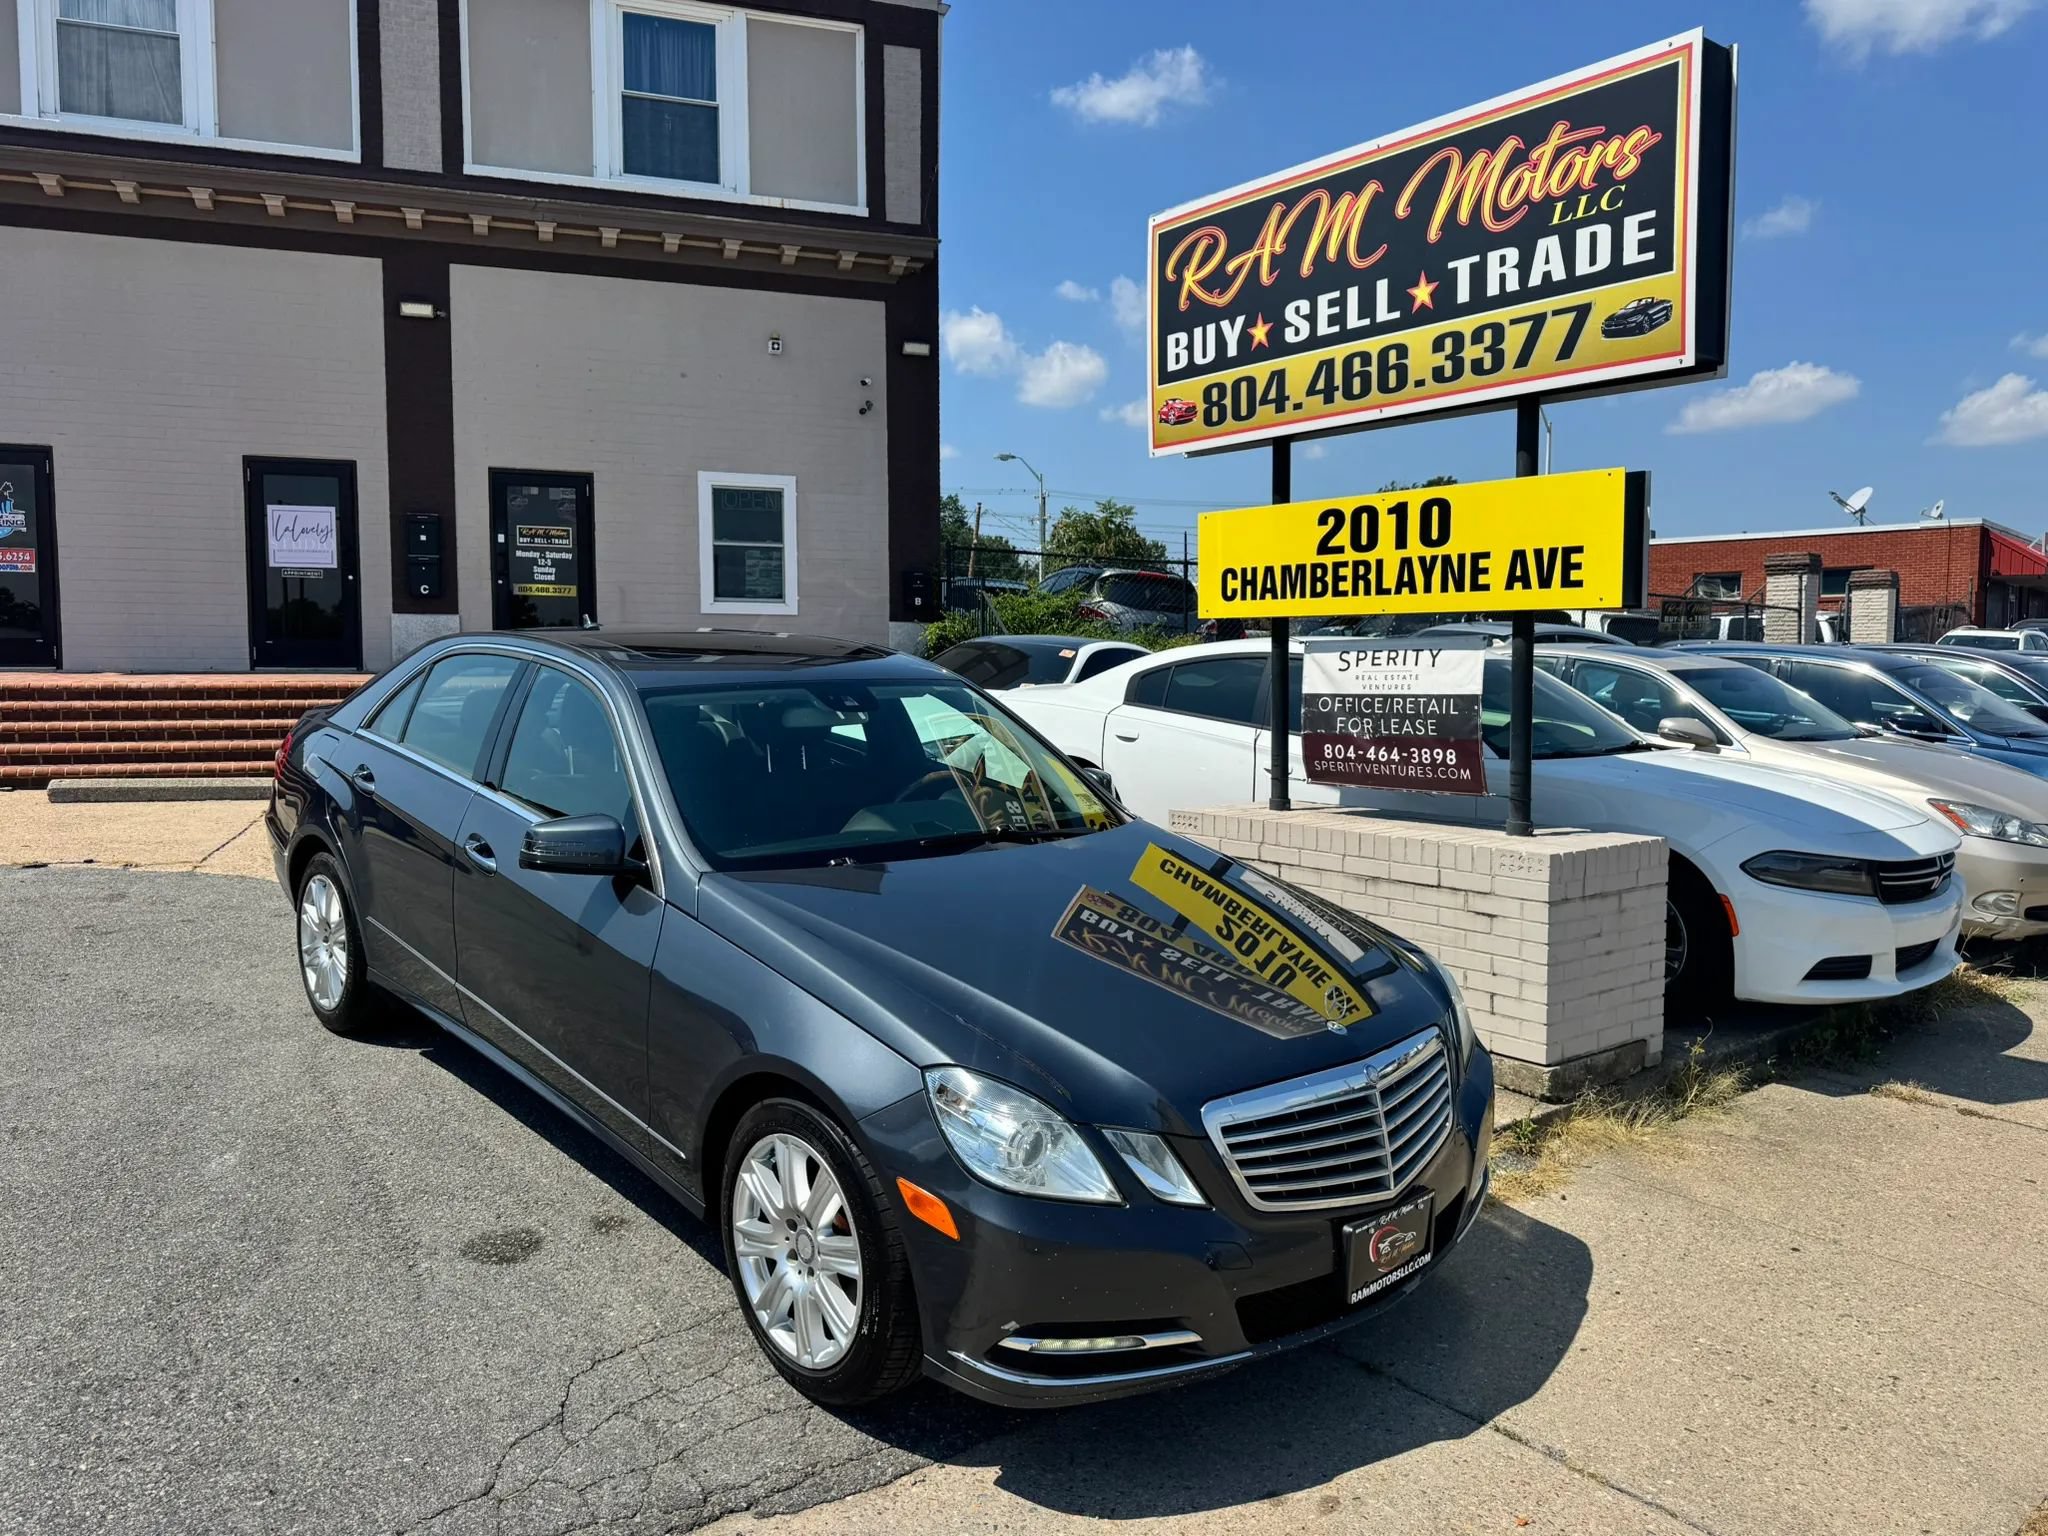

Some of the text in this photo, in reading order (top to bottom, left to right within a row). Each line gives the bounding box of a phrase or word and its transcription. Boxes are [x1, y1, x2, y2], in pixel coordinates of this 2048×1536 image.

[1166, 120, 1662, 312] RAM Motors
[1550, 184, 1626, 227] LLC
[1167, 209, 1657, 373] BUY SELL TRADE
[1201, 302, 1595, 427] 804.466.3377
[725, 491, 777, 509] OPEN
[1315, 497, 1452, 556] 2010
[516, 550, 540, 558] Monday
[545, 551, 573, 560] Saturday
[533, 566, 556, 574] Sunday
[534, 573, 556, 581] Closed
[1220, 545, 1585, 602] CHAMBERLAYNE AVE
[420, 585, 430, 594] C
[1338, 648, 1443, 672] SPERITY
[1318, 696, 1460, 715] OFFICE/RETAIL
[1336, 717, 1439, 736] FOR LEASE
[1323, 743, 1457, 765] 804-464-3898
[1314, 760, 1472, 780] SPERITYVENTURES.COM
